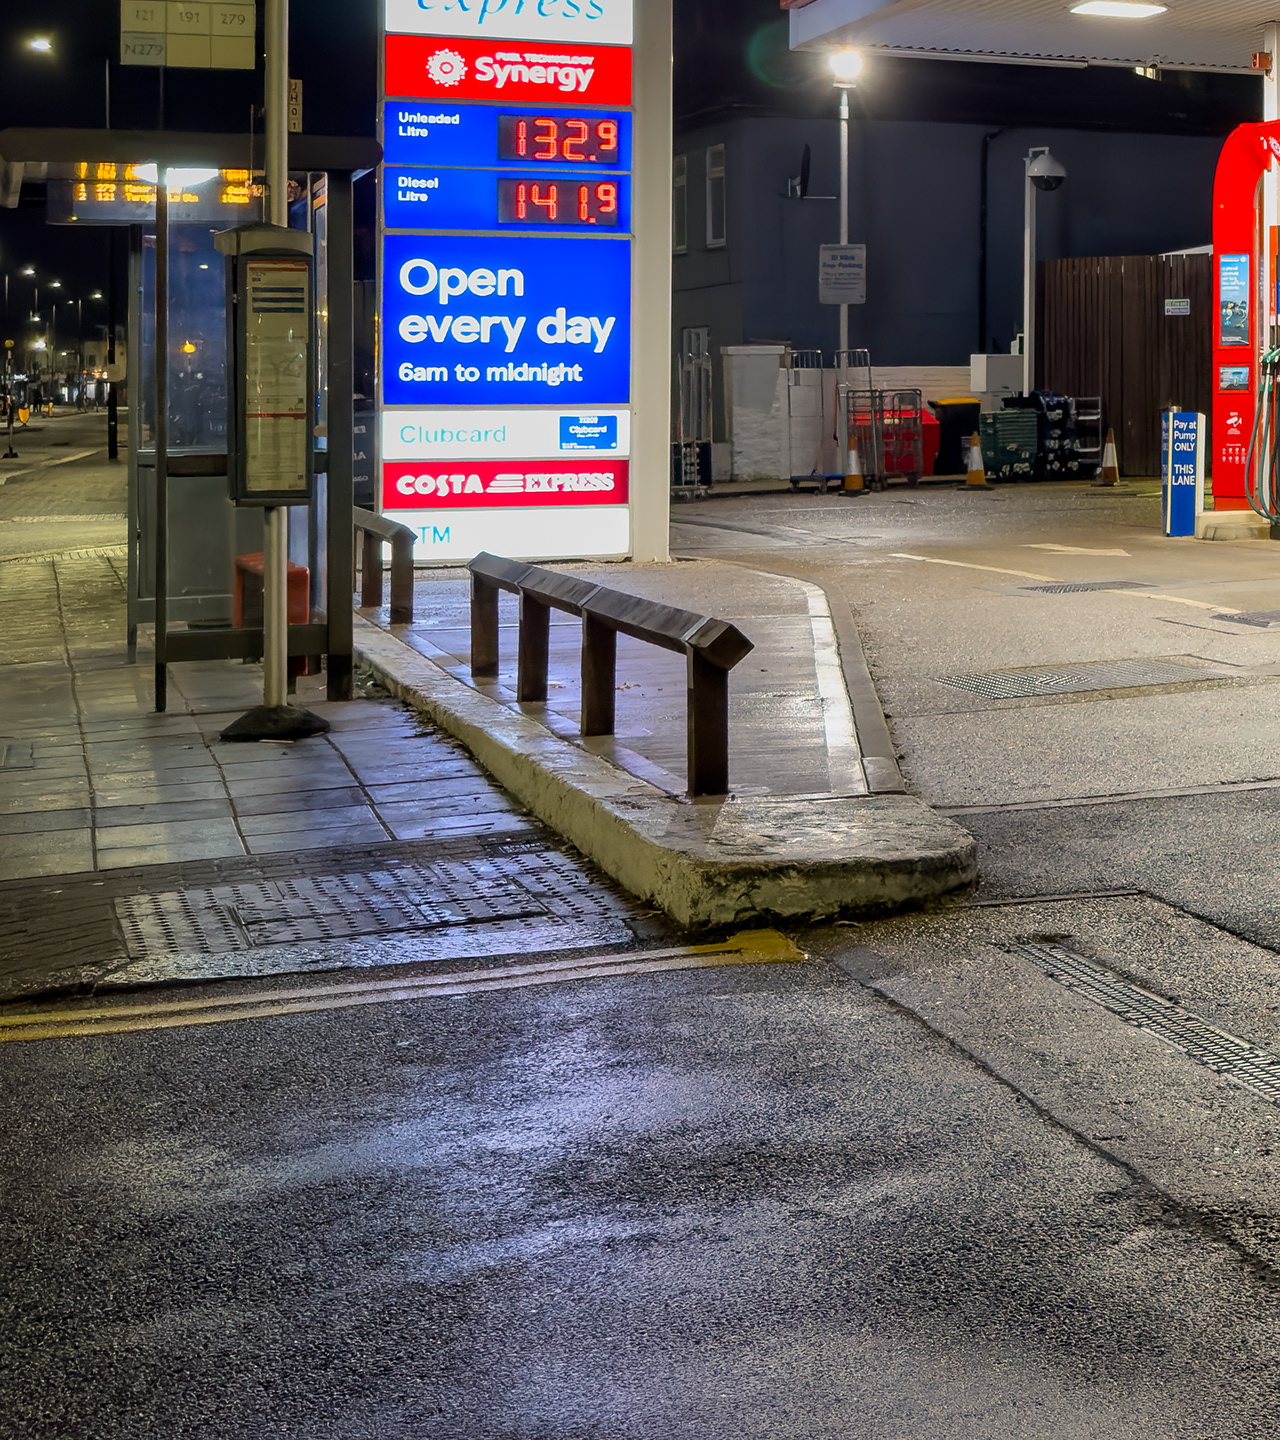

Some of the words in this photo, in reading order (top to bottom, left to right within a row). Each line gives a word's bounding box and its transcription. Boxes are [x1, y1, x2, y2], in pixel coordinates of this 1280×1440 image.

[179, 11, 200, 23] 191
[221, 12, 246, 25] 279
[124, 43, 164, 56] N279
[475, 56, 595, 92] Synergy
[398, 111, 460, 125] Unleaded
[398, 125, 428, 137] Litre
[398, 176, 439, 189] Diesel
[397, 191, 428, 202] Litre
[399, 258, 525, 305] Open
[398, 314, 527, 353] every
[536, 307, 616, 353] day
[398, 362, 448, 382] 6am
[454, 363, 480, 382] to
[486, 362, 583, 386] midnight
[1173, 419, 1188, 431] Pay
[1188, 420, 1197, 430] at
[400, 425, 507, 444] Clubcard
[1173, 430, 1197, 442] Pump
[1174, 442, 1196, 452] ONLY
[1173, 463, 1195, 475] THIS
[396, 474, 484, 497] COSTA
[524, 472, 615, 493] EXPRESS
[1171, 475, 1196, 486] LANE
[413, 526, 451, 544] TM
